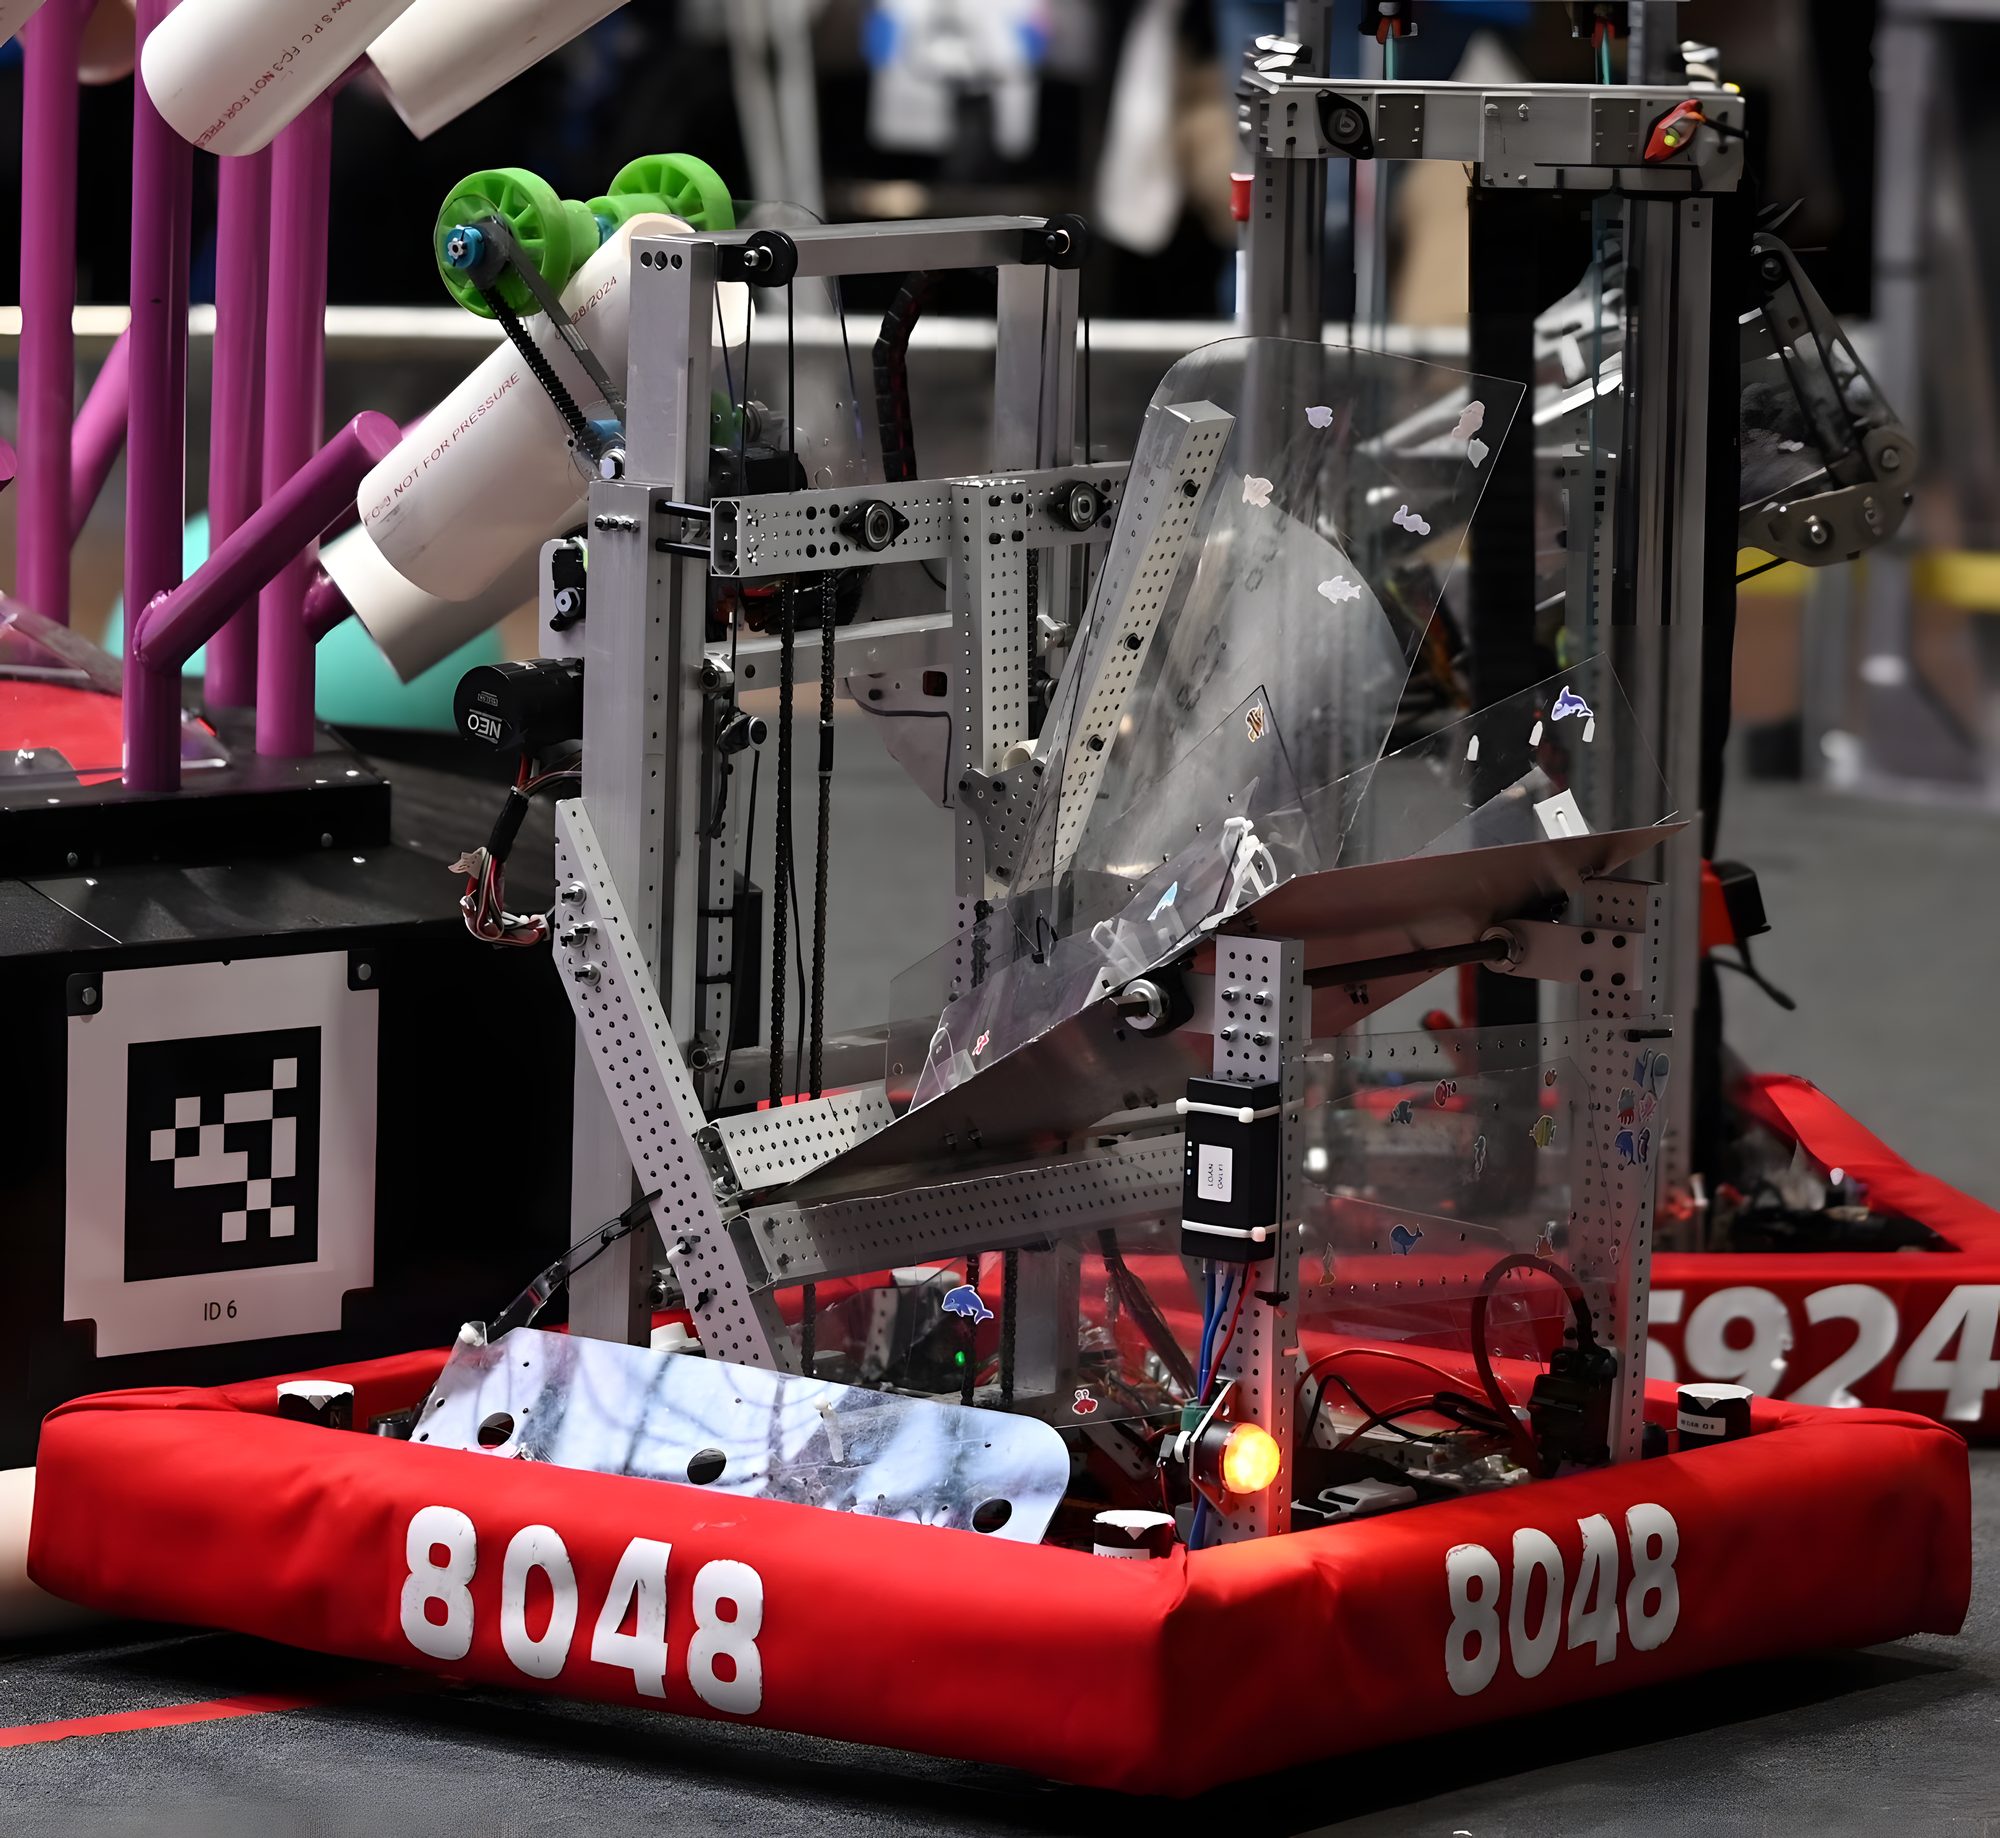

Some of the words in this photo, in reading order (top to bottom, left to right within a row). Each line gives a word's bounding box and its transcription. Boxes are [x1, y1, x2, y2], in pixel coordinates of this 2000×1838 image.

[393, 467, 420, 498] NOT
[423, 439, 451, 469] FOR
[452, 371, 521, 442] PRESSURE
[467, 714, 502, 739] NEO
[204, 1301, 222, 1321] ID
[226, 1299, 238, 1319] 6
[400, 1505, 764, 1715] 8048
[1445, 1502, 1680, 1696] 8048
